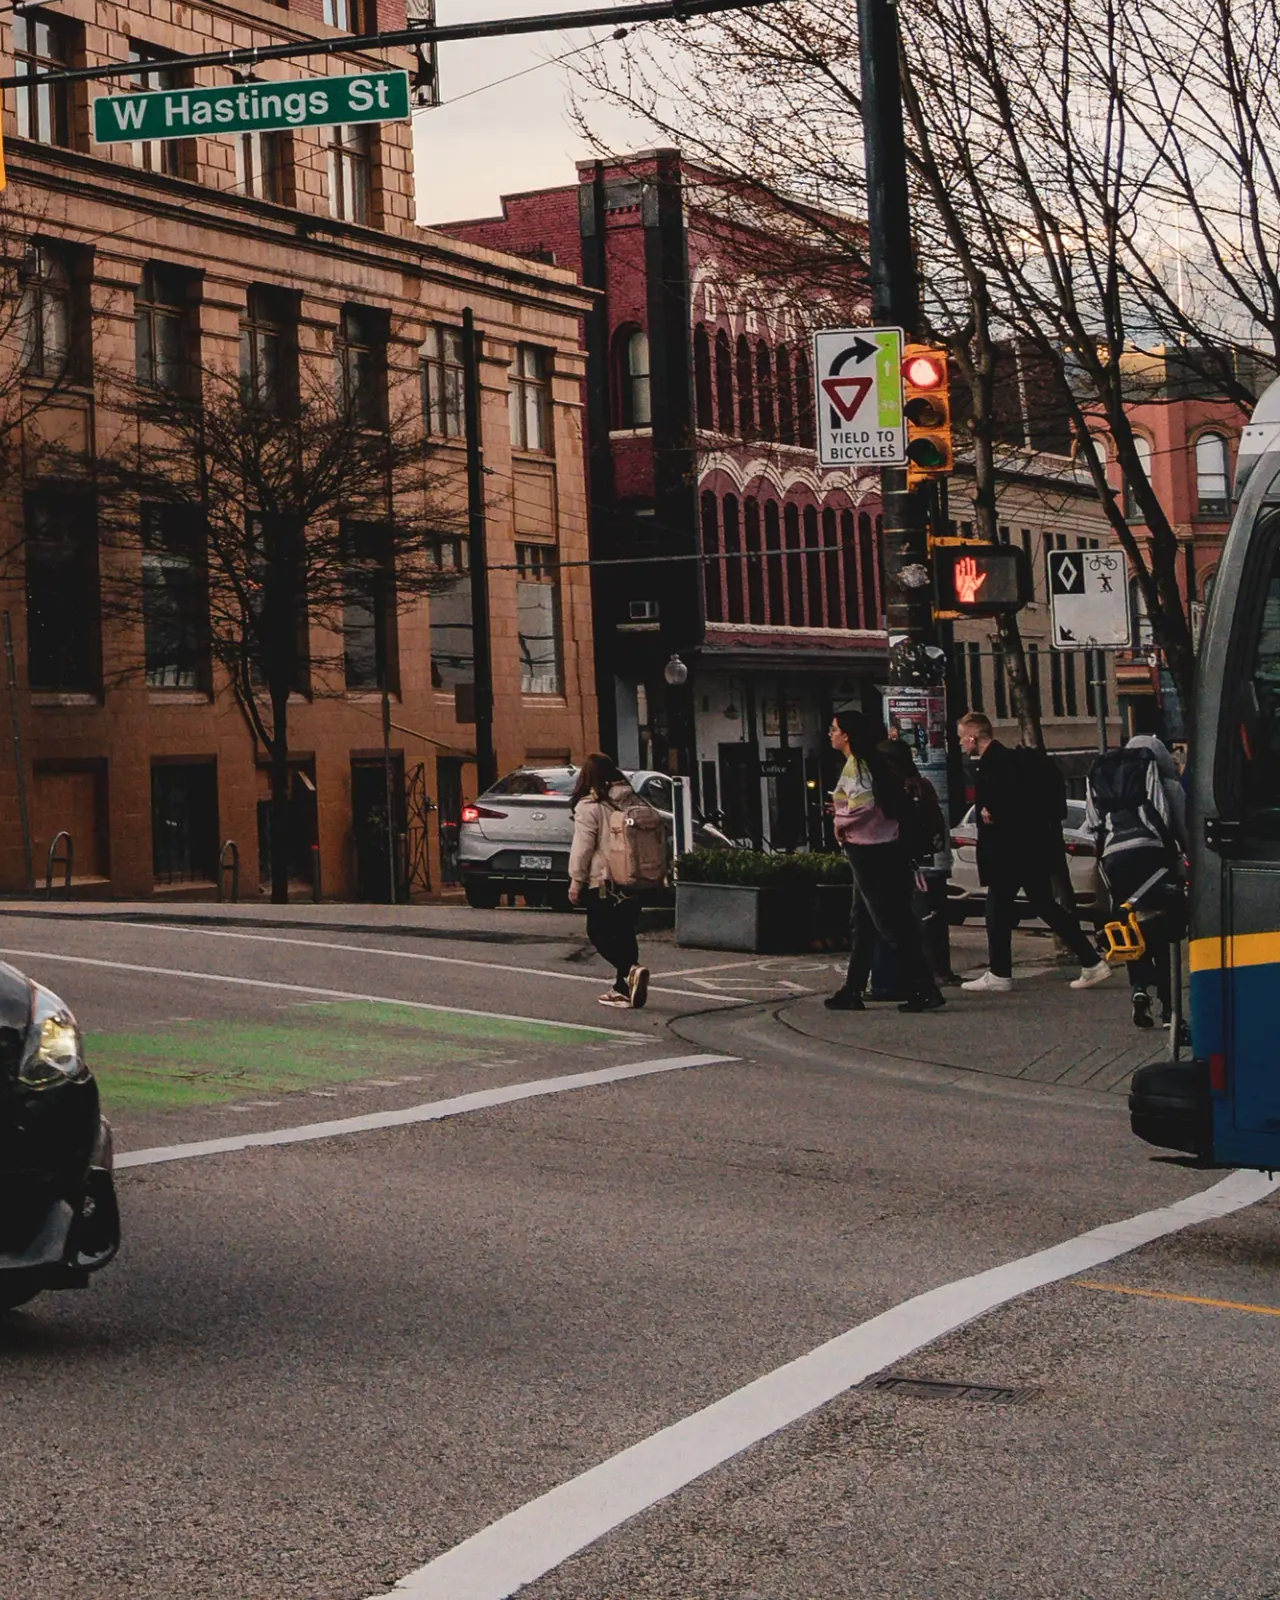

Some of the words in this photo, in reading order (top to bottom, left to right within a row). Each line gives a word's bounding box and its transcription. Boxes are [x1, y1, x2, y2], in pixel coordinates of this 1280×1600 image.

[112, 99, 148, 131] W
[165, 89, 329, 127] Hastings
[348, 78, 390, 112] St
[830, 431, 870, 444] YIELD
[876, 430, 895, 443] TO
[830, 445, 896, 459] BICYCLES
